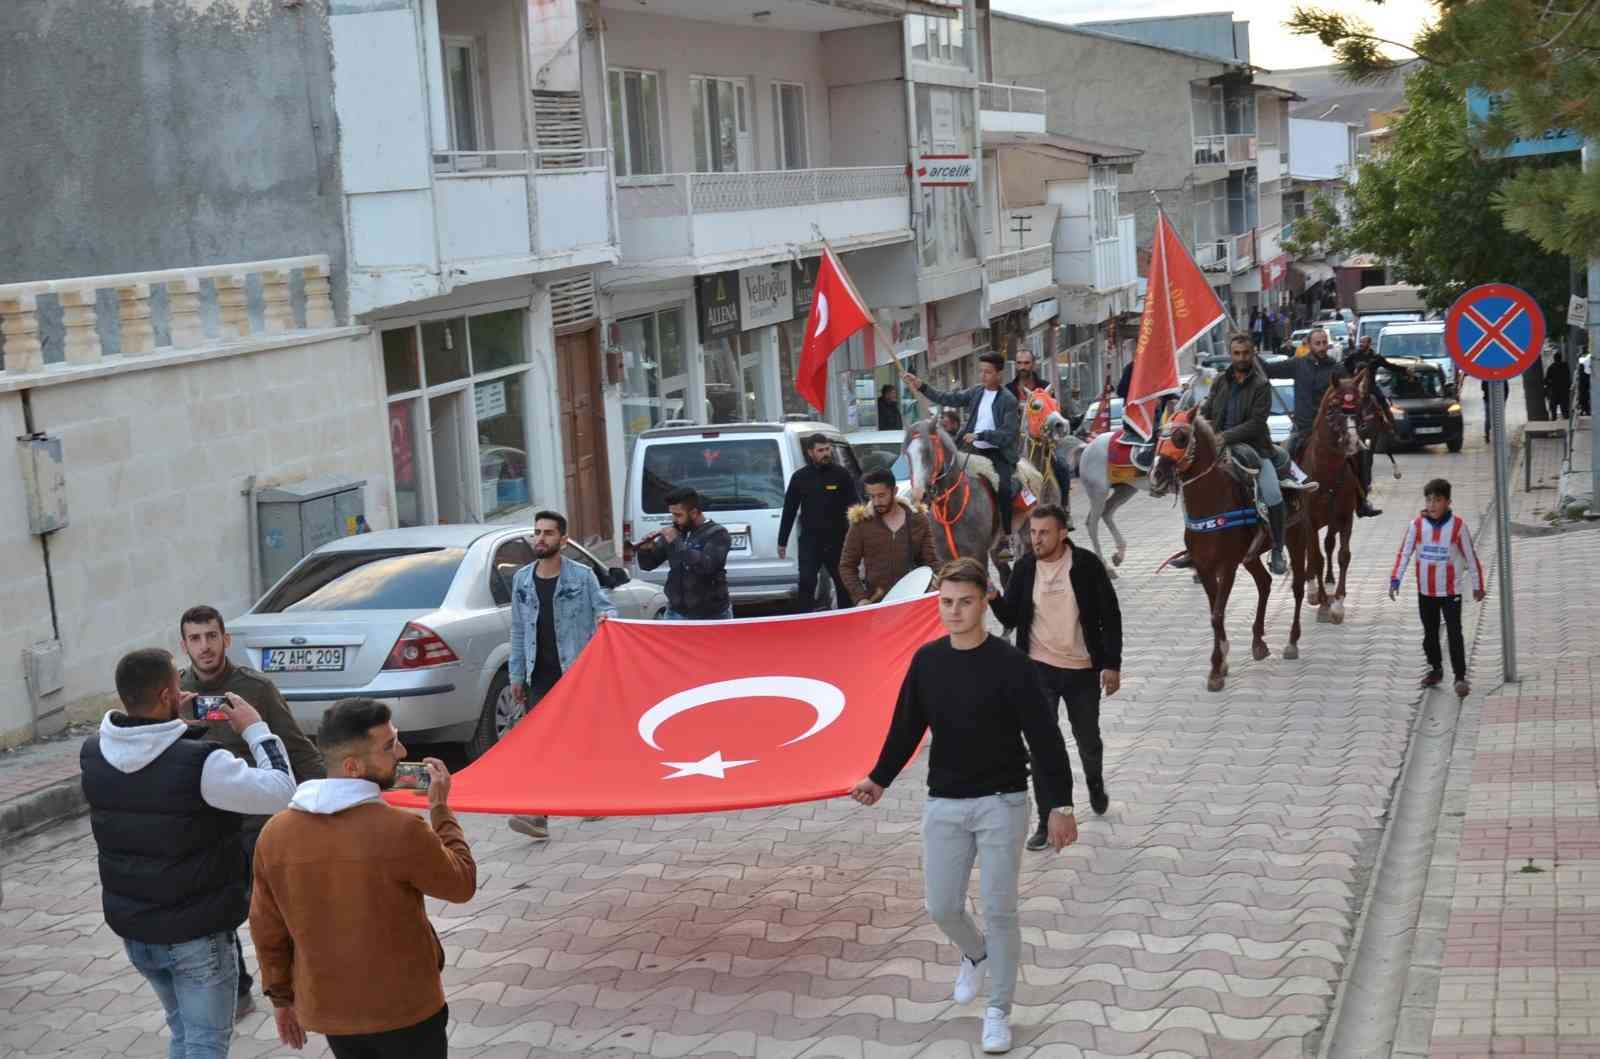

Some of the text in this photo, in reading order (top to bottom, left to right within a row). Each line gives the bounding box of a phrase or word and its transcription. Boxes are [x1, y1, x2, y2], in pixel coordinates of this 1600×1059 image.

[270, 649, 341, 665] 42 AHC 209
